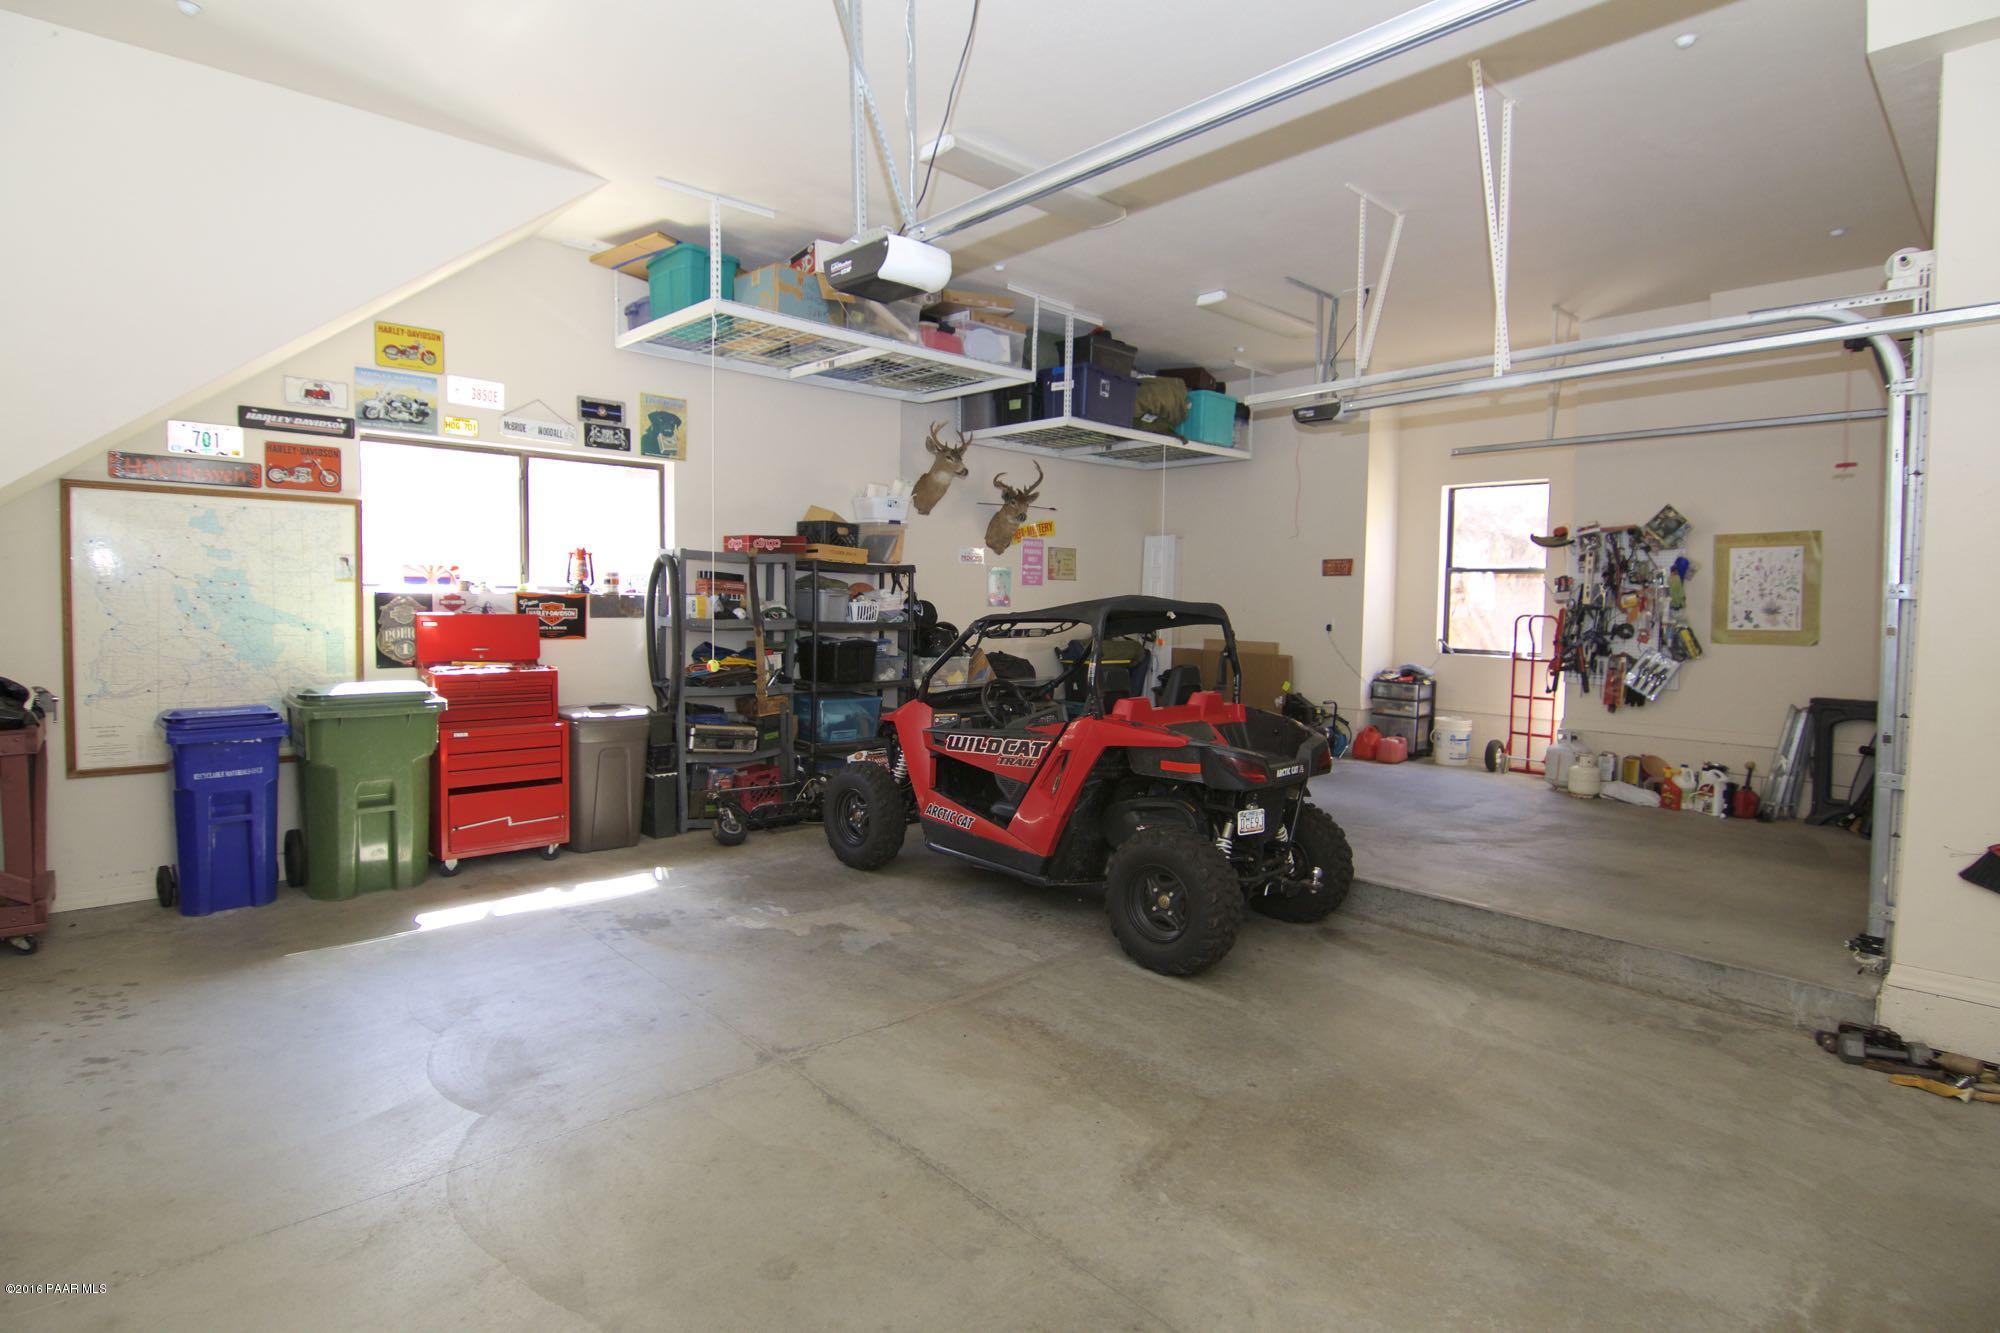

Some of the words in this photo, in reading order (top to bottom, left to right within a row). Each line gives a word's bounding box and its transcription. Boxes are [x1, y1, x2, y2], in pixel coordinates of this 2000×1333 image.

[245, 412, 347, 430] HARLEY-DAVIDSON
[504, 421, 527, 433] McBRIDE
[538, 426, 563, 439] WOODALL
[192, 430, 219, 449] 701
[528, 608, 577, 617] HARLEY-DAVIDSON
[946, 734, 1051, 758] WILDCAT
[997, 756, 1038, 768] TRAIL
[1276, 767, 1291, 778] ARCTIC
[1291, 765, 1299, 775] CAT
[925, 803, 958, 822] ARCTIC
[956, 813, 976, 830] CAT
